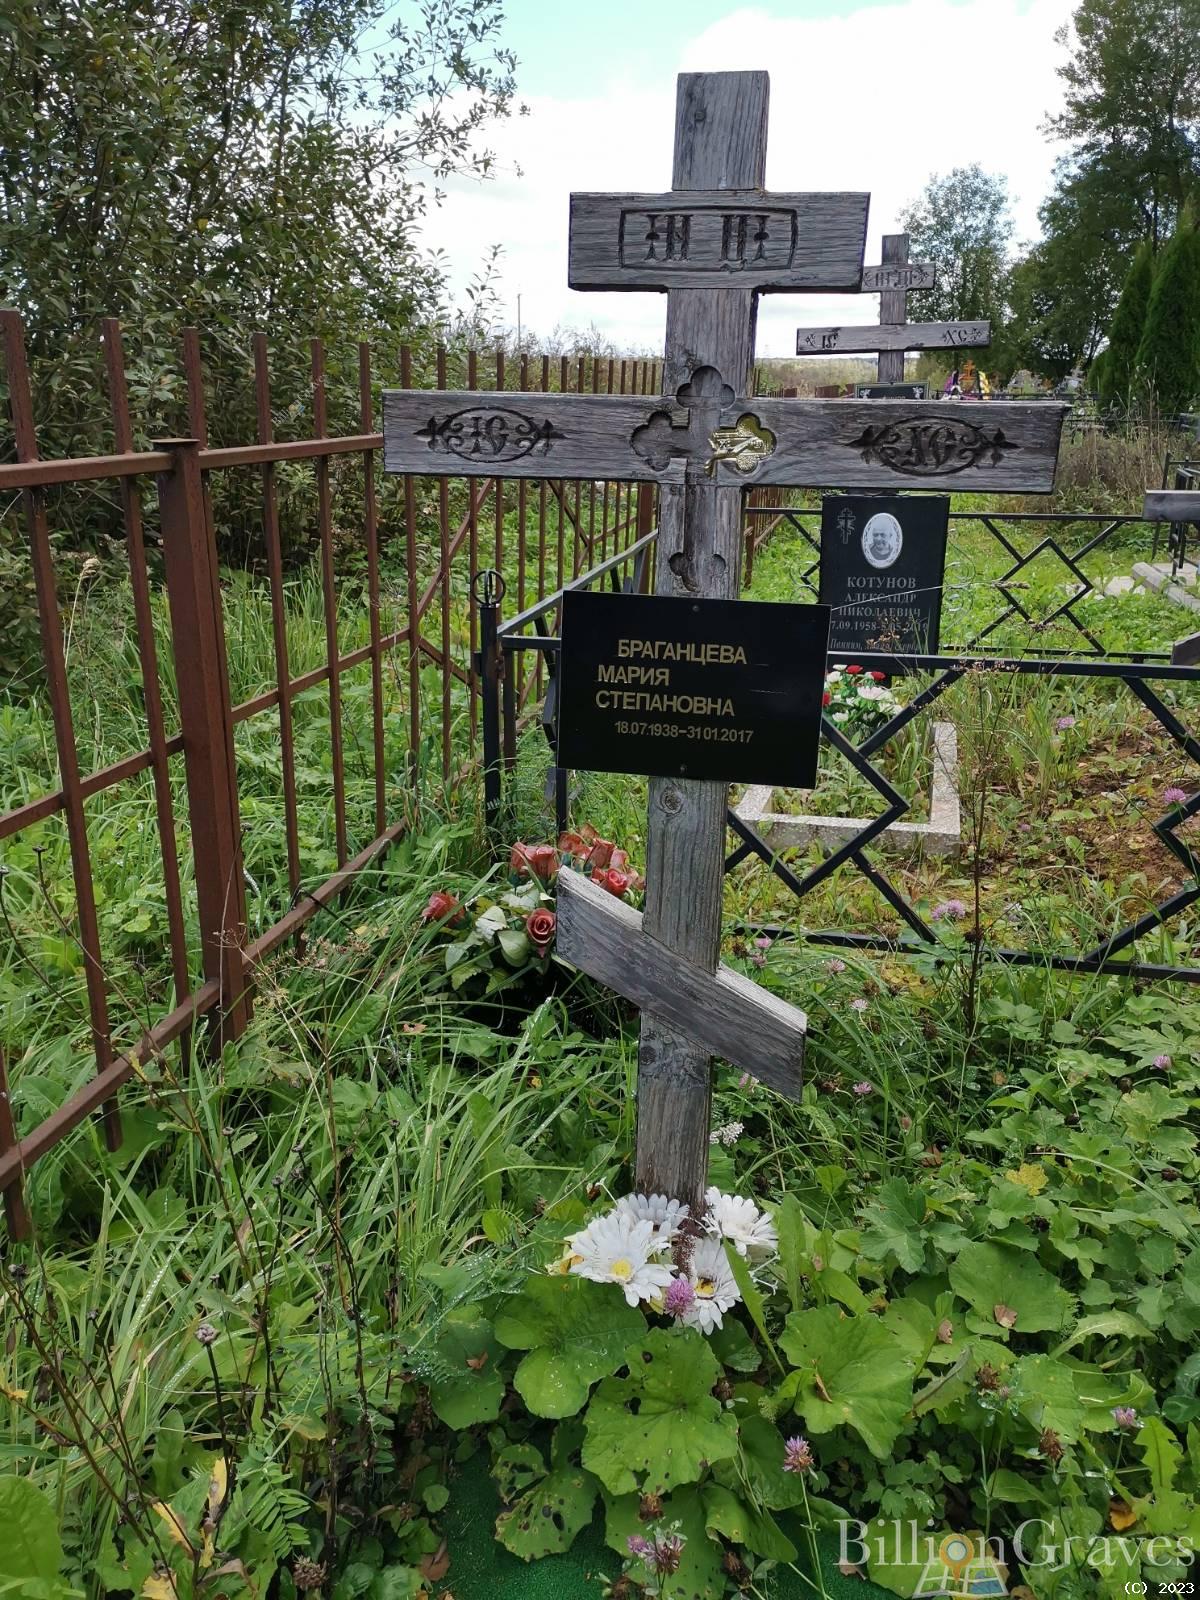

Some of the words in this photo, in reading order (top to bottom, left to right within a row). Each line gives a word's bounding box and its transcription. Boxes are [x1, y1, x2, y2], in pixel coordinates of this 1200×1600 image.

[847, 576, 917, 589] КОТУНОВ
[839, 606, 921, 617] НИКОЛАЕВИЧ
[617, 639, 748, 666] БРАГАНЦЕВА
[598, 664, 670, 687] МАРИЯ
[595, 690, 736, 717] СТЕПАНОВНА
